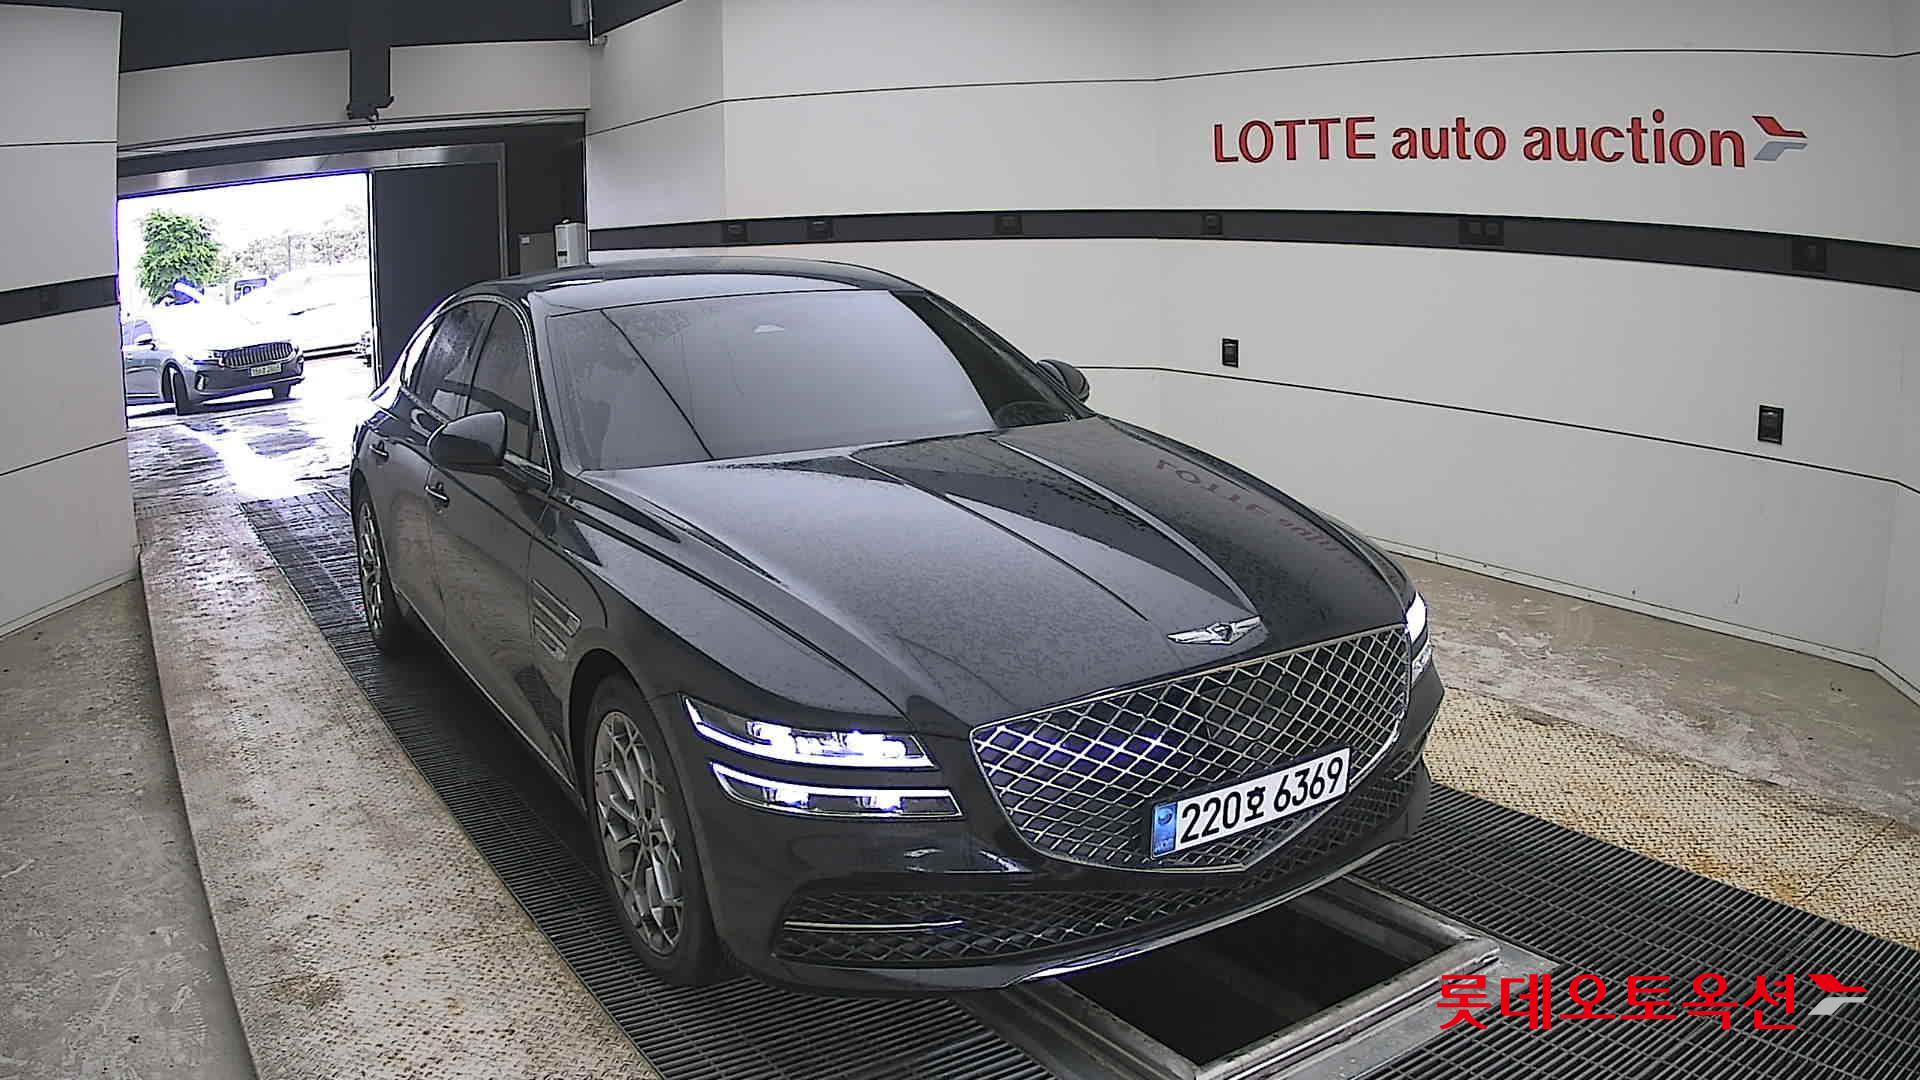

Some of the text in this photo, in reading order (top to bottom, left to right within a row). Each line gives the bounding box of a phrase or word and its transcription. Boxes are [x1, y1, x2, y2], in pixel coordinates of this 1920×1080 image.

[1213, 108, 1746, 168] LOTTE auto auction
[1180, 757, 1344, 844] 220호 6369
